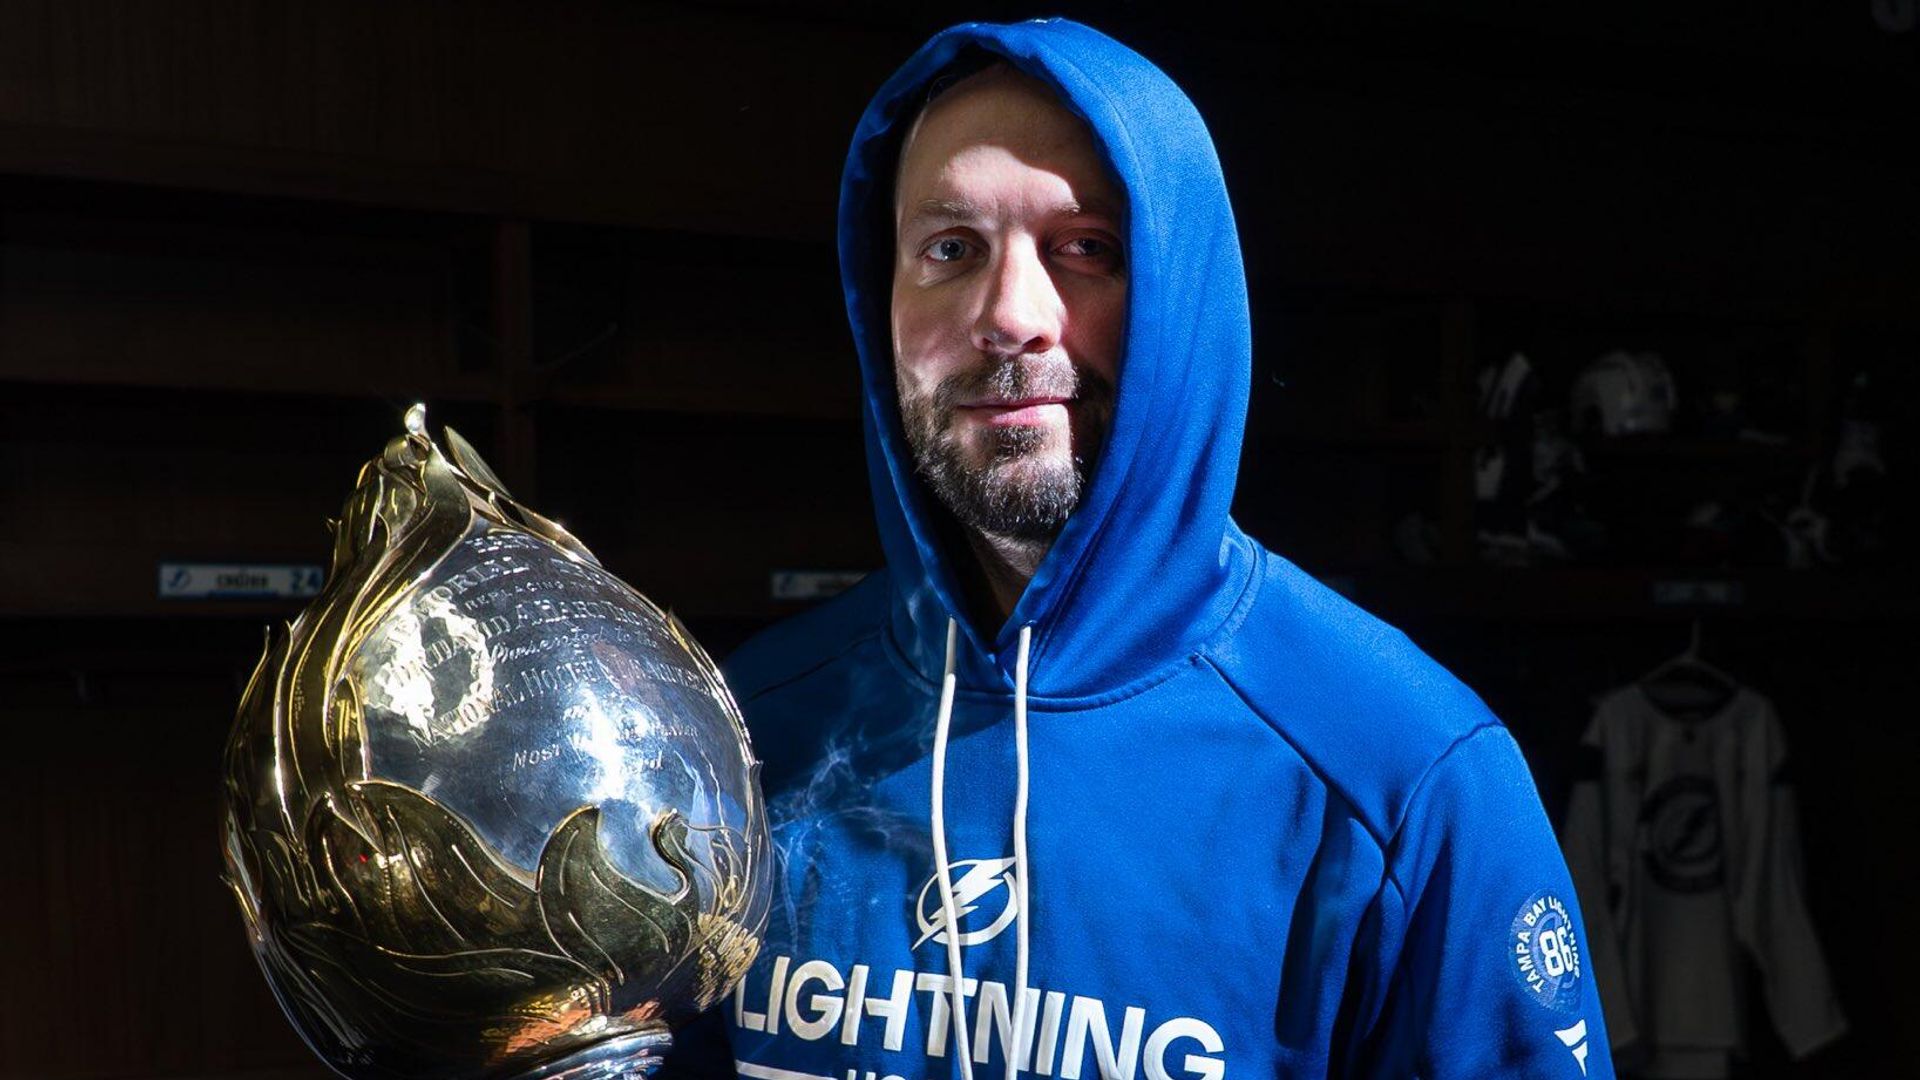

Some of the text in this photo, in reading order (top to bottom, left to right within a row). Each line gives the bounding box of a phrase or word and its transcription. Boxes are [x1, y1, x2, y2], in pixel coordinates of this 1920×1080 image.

[289, 568, 322, 592] 24
[1523, 897, 1547, 927] BAY
[1516, 931, 1546, 994] TAMPA
[1539, 926, 1574, 977] 86
[734, 956, 1226, 1080] LIGHTNING
